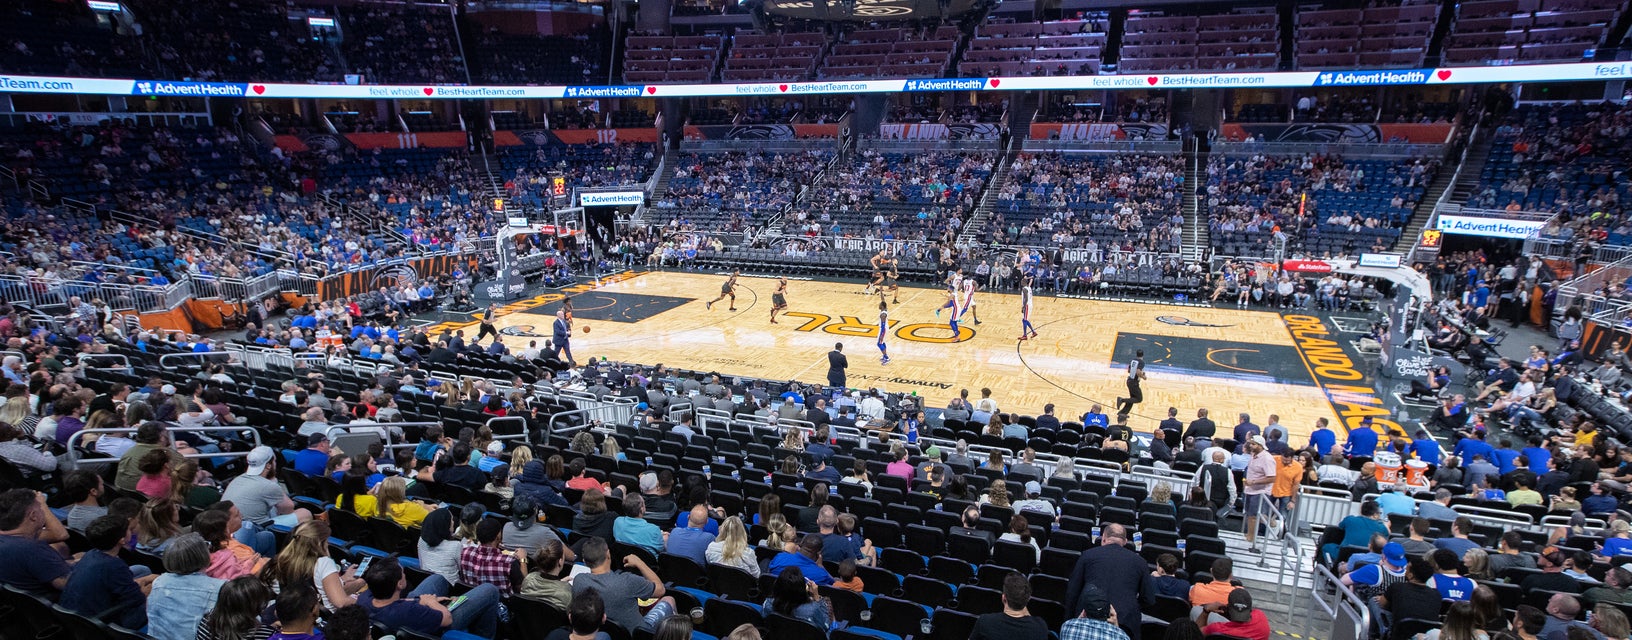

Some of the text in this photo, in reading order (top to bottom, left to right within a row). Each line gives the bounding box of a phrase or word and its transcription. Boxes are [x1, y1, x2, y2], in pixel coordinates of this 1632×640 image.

[1595, 64, 1625, 76] feel
[1092, 76, 1144, 86] feel whole
[1162, 75, 1265, 86] BestHeartTeam.com
[1335, 71, 1425, 84] AdventHealth
[154, 82, 243, 96] AdventHealth
[735, 84, 777, 93] feel whole
[791, 82, 868, 92] BestHeartTeam.com
[917, 79, 982, 90] AdventHealth
[369, 86, 420, 96] feel whole
[437, 87, 526, 96] BestHeartTeam.com
[578, 86, 641, 97] AdventHealth
[397, 133, 418, 149] 111
[597, 129, 617, 144] 112
[591, 194, 642, 203] AdventHealth
[1454, 220, 1541, 236] AdventHealth
[783, 311, 977, 344] ORL
[1283, 314, 1363, 380] ORLANDO
[1395, 358, 1420, 369] Olive
[1397, 366, 1430, 377] Garde
